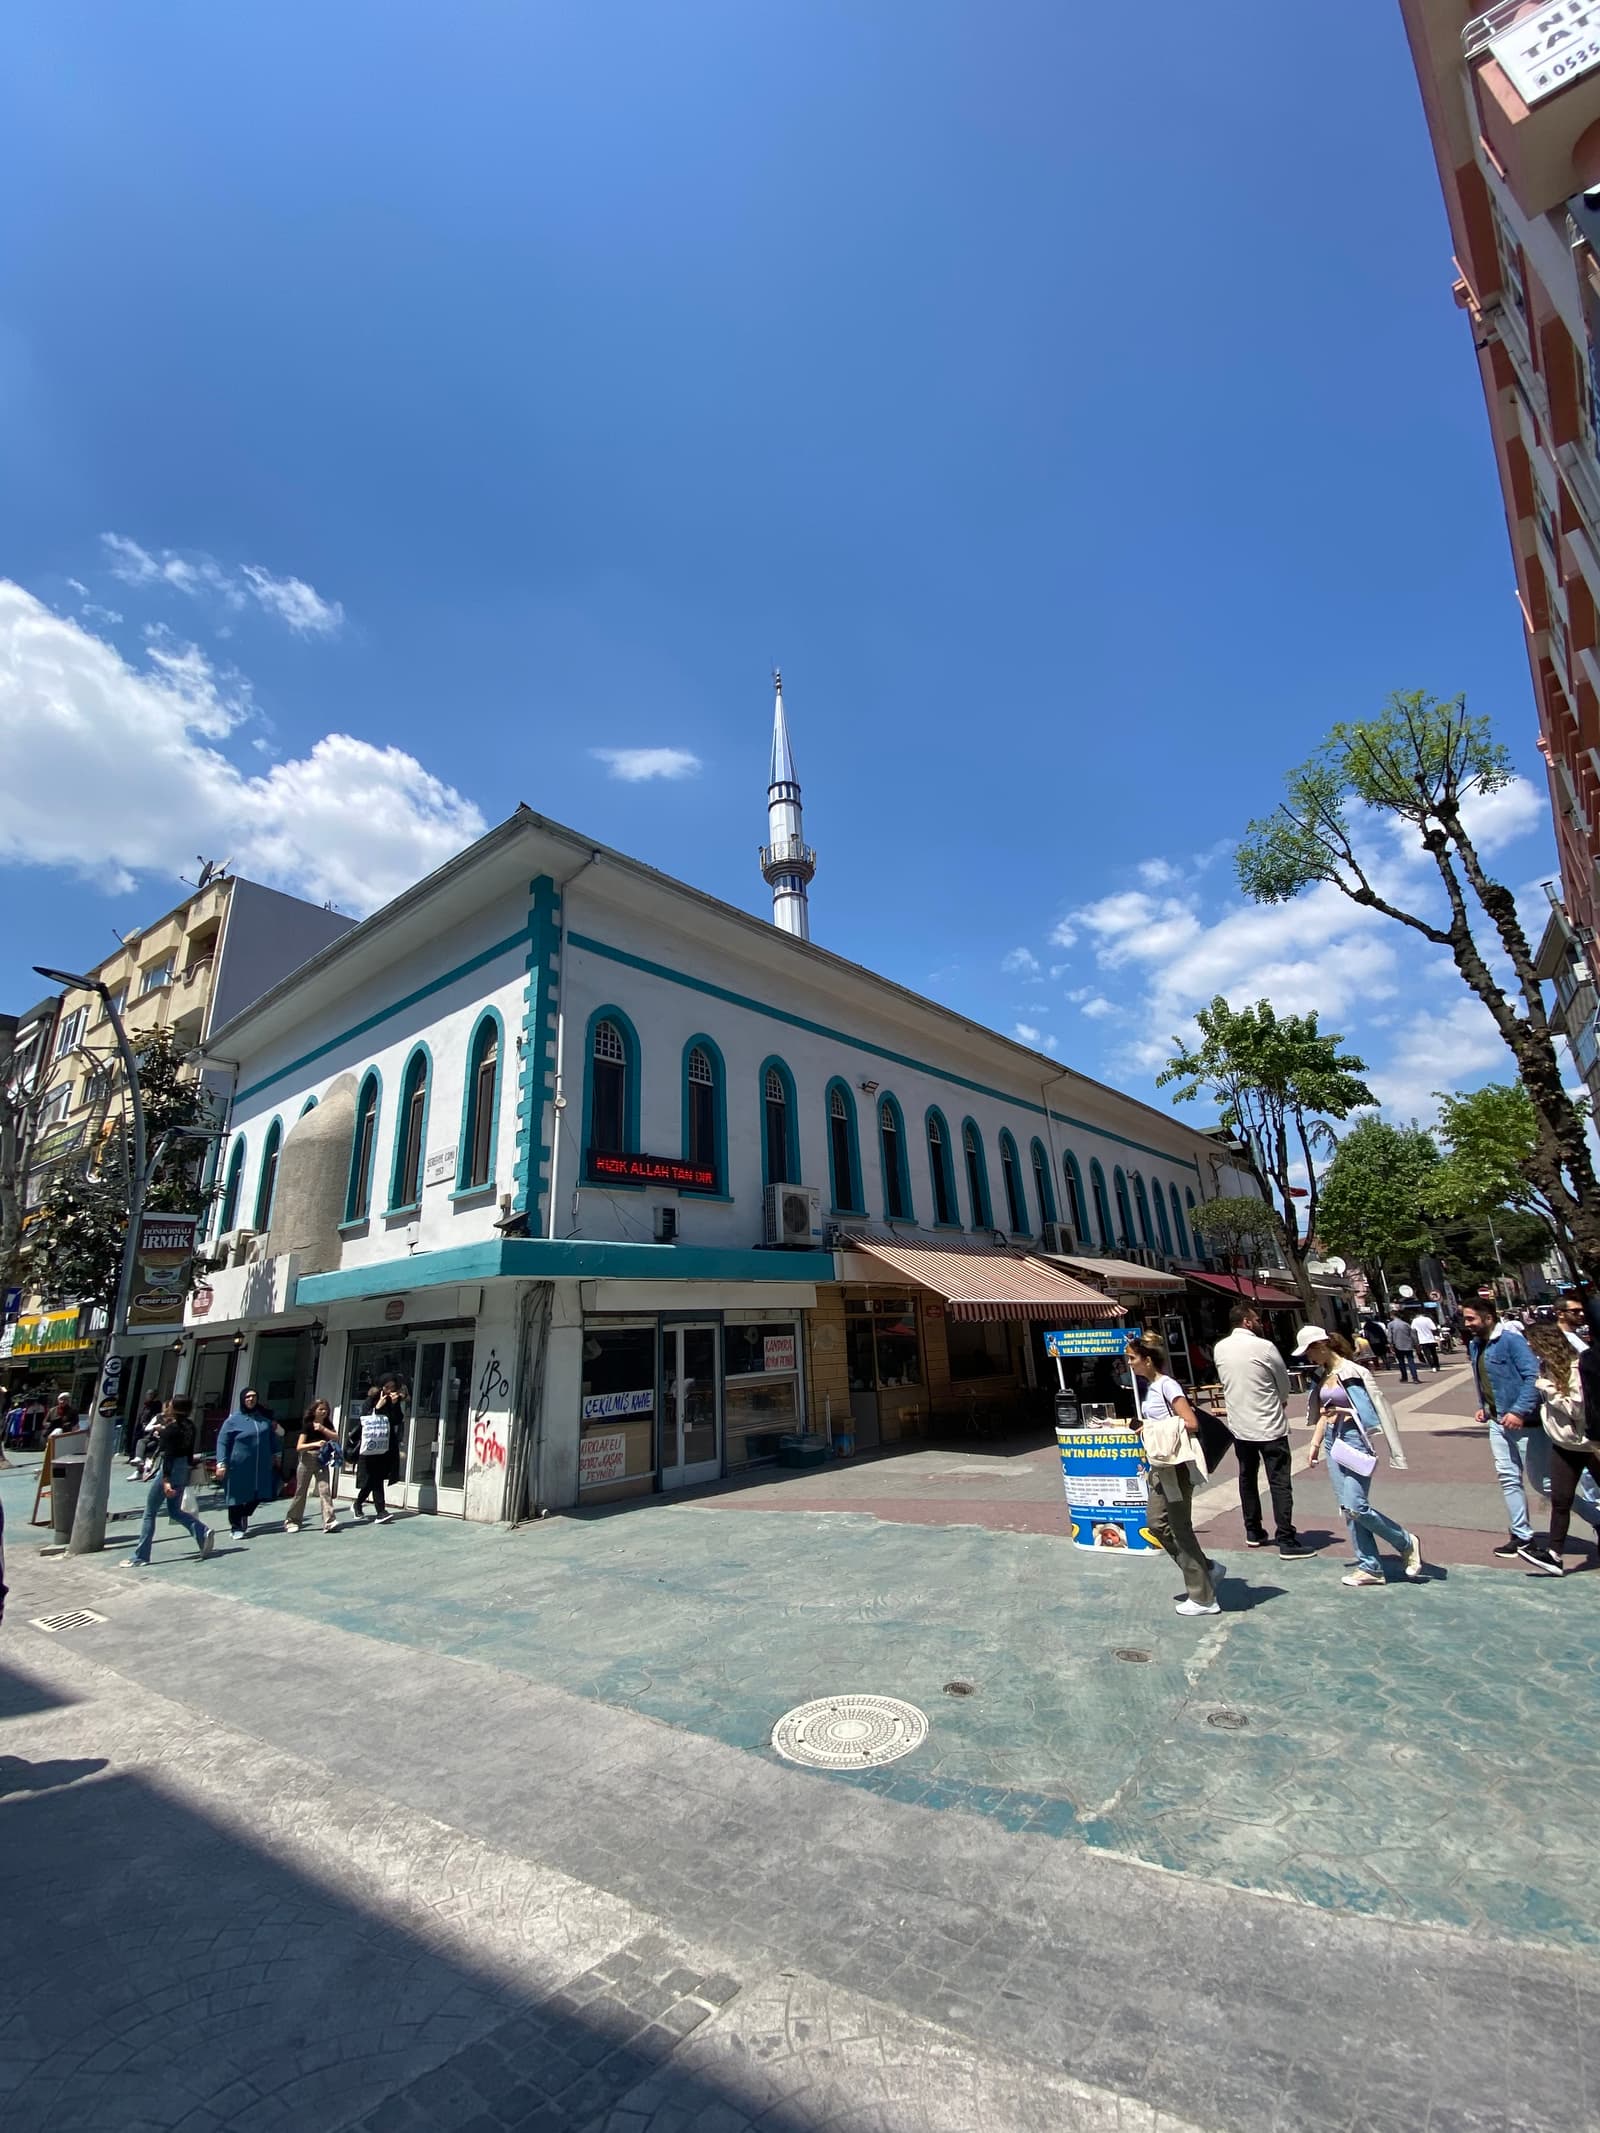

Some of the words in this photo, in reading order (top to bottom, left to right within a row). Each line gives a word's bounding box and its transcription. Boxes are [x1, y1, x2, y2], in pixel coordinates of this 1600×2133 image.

[630, 1162, 669, 1179] ALLAH
[671, 1167, 693, 1180] TAN
[1073, 1435, 1093, 1445] KAS
[1094, 1434, 1139, 1445] HASTASI
[1086, 1446, 1118, 1461] BAĞIŞ
